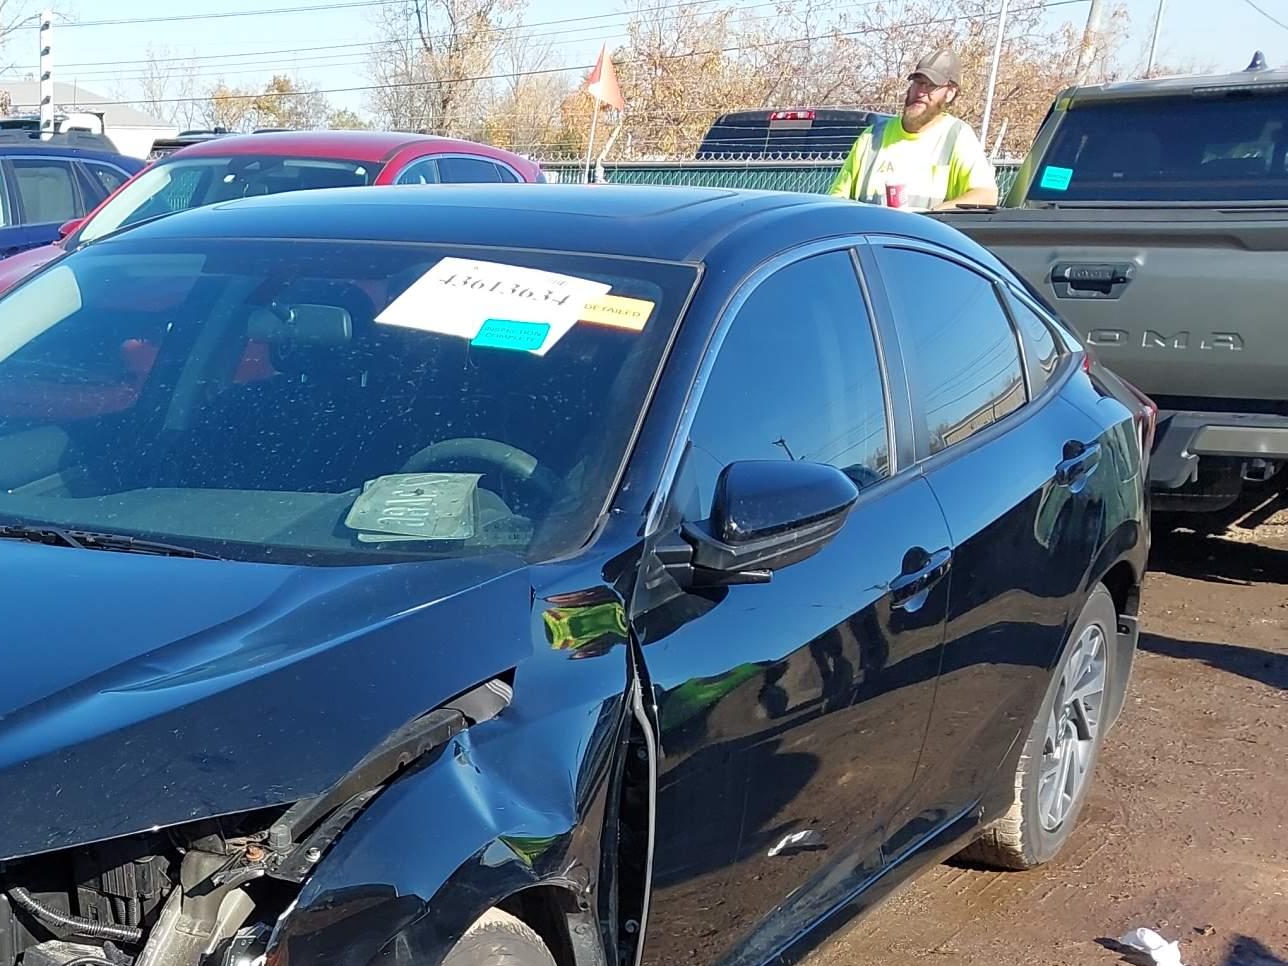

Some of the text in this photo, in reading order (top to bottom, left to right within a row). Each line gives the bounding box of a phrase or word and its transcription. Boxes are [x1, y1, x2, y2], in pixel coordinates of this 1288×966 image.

[439, 273, 571, 306] 43613634
[583, 303, 641, 317] DETAILED
[1086, 328, 1244, 350] OMA
